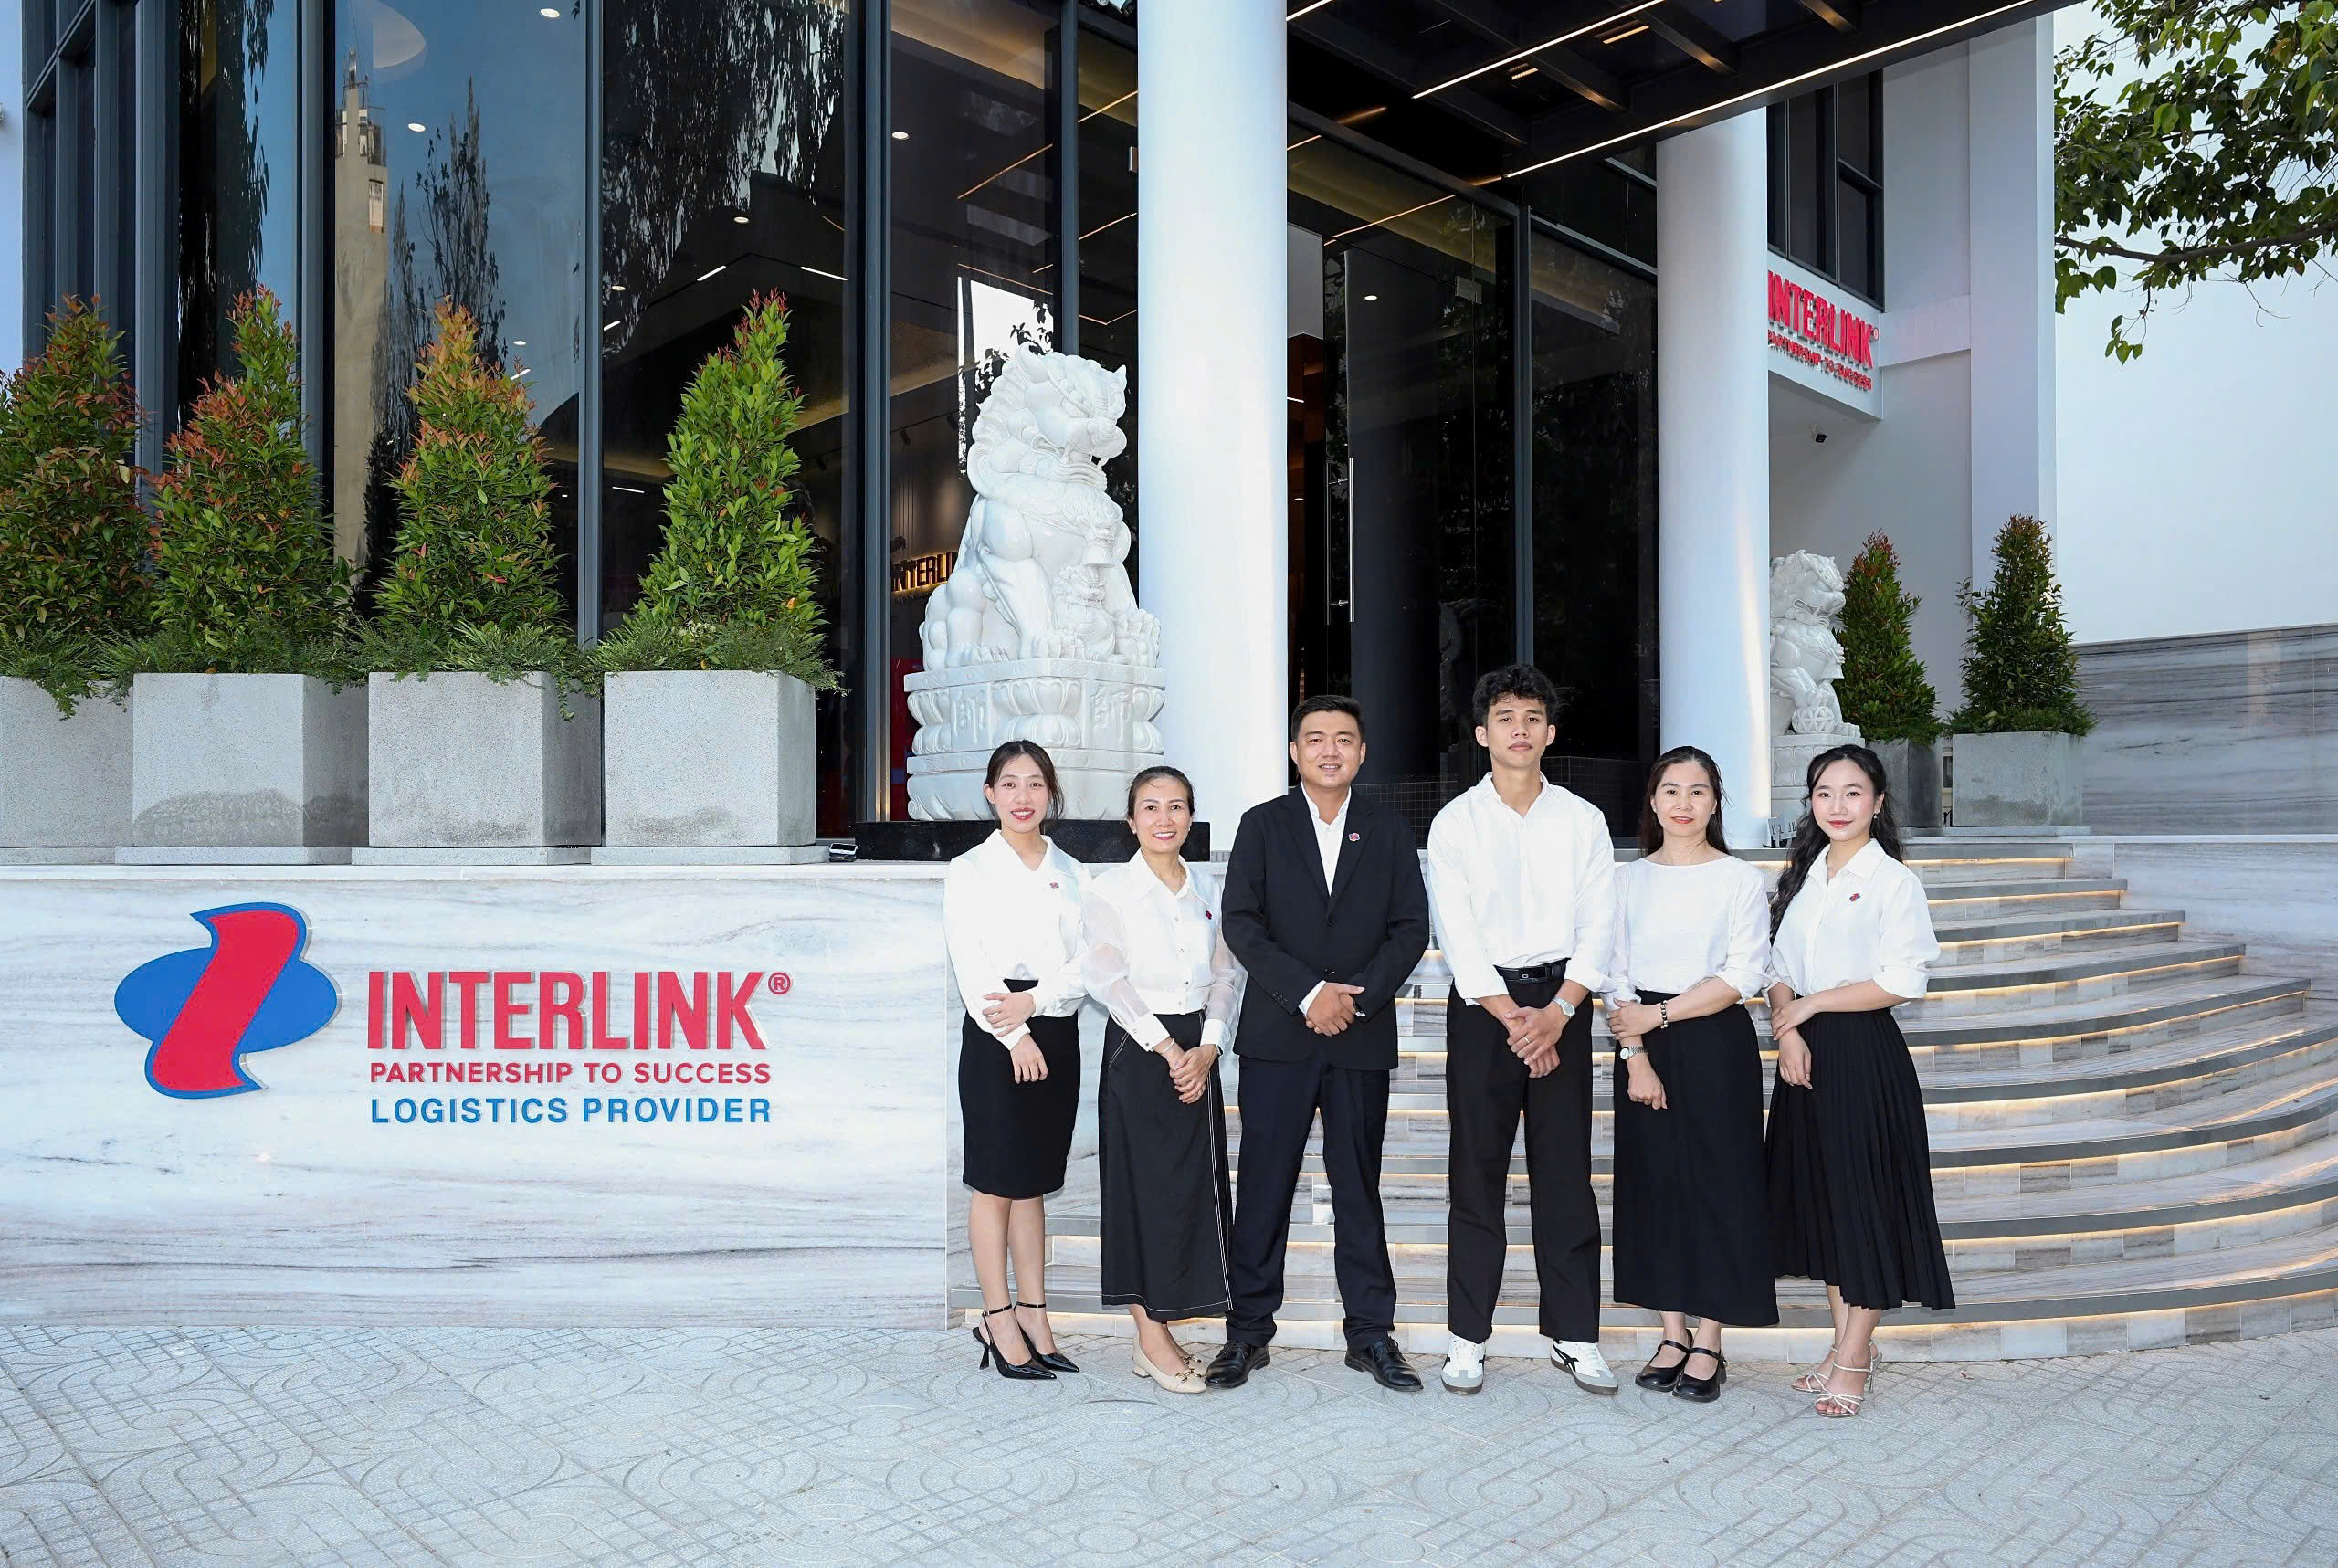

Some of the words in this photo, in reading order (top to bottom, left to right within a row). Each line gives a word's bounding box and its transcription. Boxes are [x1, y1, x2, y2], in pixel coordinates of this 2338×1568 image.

[371, 1062, 572, 1083] PARTNERSHIP
[584, 1062, 622, 1083] TO
[635, 1062, 770, 1083] SUCCESS
[372, 1097, 566, 1123] LOGISTICS
[583, 1097, 770, 1123] PROVIDER
